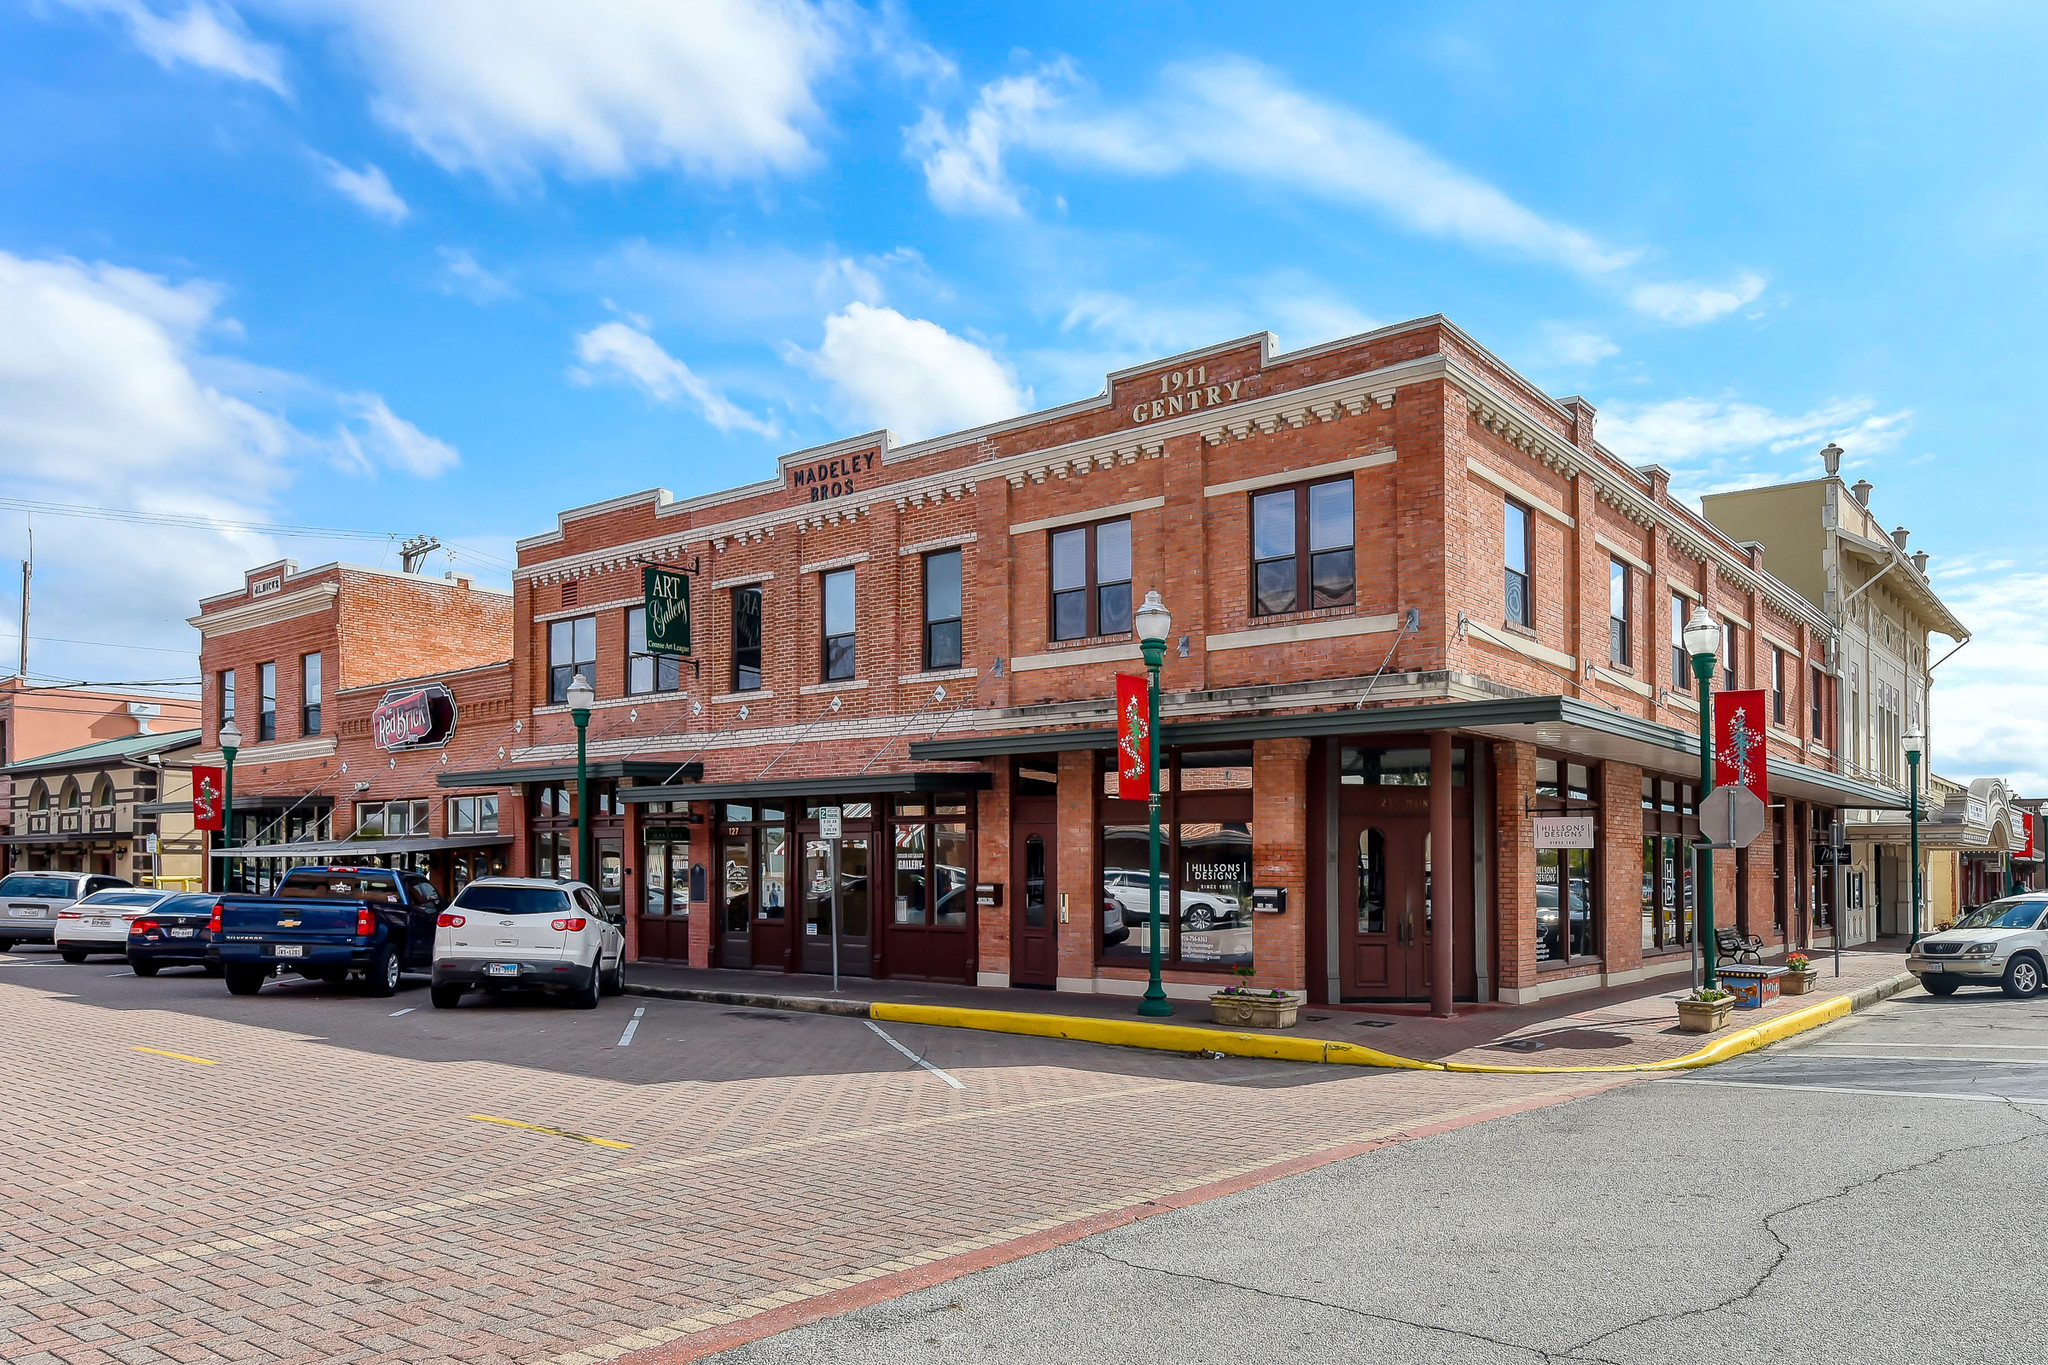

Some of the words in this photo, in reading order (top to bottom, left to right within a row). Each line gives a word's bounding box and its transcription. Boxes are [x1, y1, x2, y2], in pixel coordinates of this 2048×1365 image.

[1160, 365, 1207, 394] 1911
[1132, 379, 1242, 423] GENTRY
[794, 451, 874, 488] MADELEY
[811, 478, 854, 503] BROS
[652, 574, 680, 600] ART
[648, 598, 688, 638] Gallery
[379, 707, 396, 746] Red
[396, 697, 426, 740] Brick
[728, 827, 739, 836] 127
[898, 860, 922, 869] GALLERY
[1192, 864, 1240, 872] HILLSONS
[1194, 872, 1238, 880] DESIGNS
